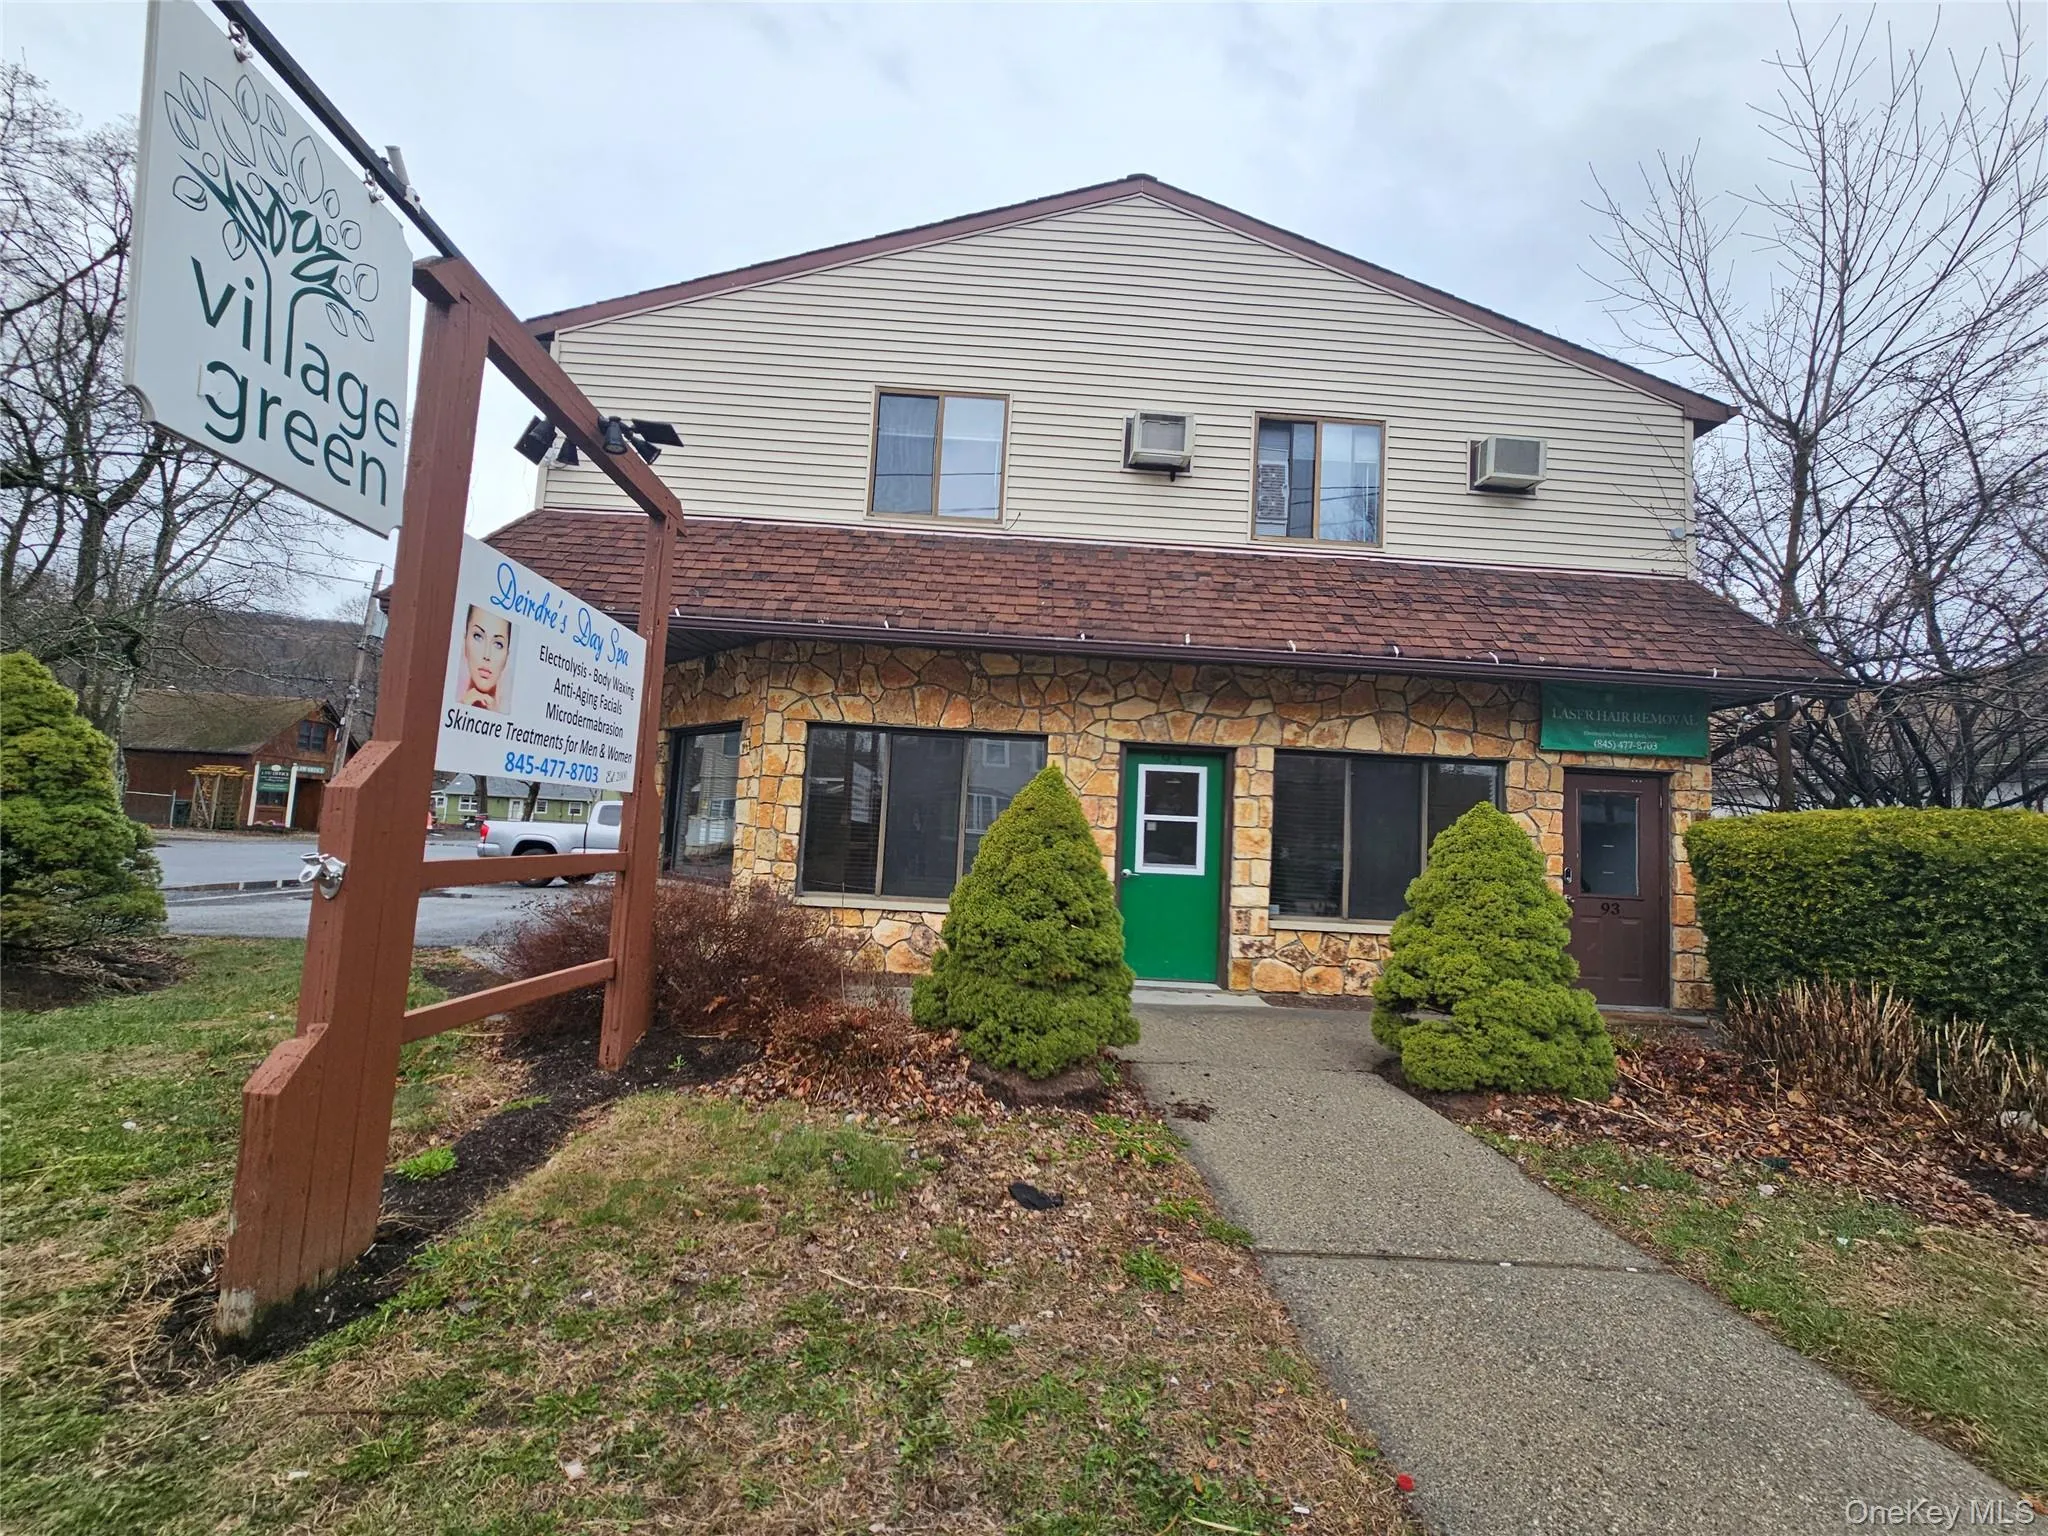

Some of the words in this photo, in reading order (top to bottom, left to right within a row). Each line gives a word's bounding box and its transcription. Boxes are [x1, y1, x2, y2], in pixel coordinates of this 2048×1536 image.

[191, 255, 400, 449] village
[204, 359, 388, 508] green
[489, 562, 568, 634] Deirdre's
[572, 607, 604, 662] Day
[607, 627, 630, 670] Spa
[540, 645, 587, 678] Electrolysis
[593, 668, 612, 691] Body
[612, 676, 635, 701] Waxing
[553, 677, 598, 710] Anti-Aging
[600, 694, 623, 715] Facials
[445, 708, 502, 738] Skincare
[505, 722, 563, 750] Treatments
[563, 735, 579, 755] for
[579, 740, 598, 757] Men
[598, 743, 605, 759] &
[607, 745, 632, 765] Women
[545, 702, 624, 738] Microdermabrasion
[1596, 710, 1631, 723] HAIR
[1633, 712, 1698, 727] REMOVAL
[1594, 738, 1617, 750] (845)
[505, 751, 599, 784] 845-477-8703
[1601, 902, 1620, 916] 93
